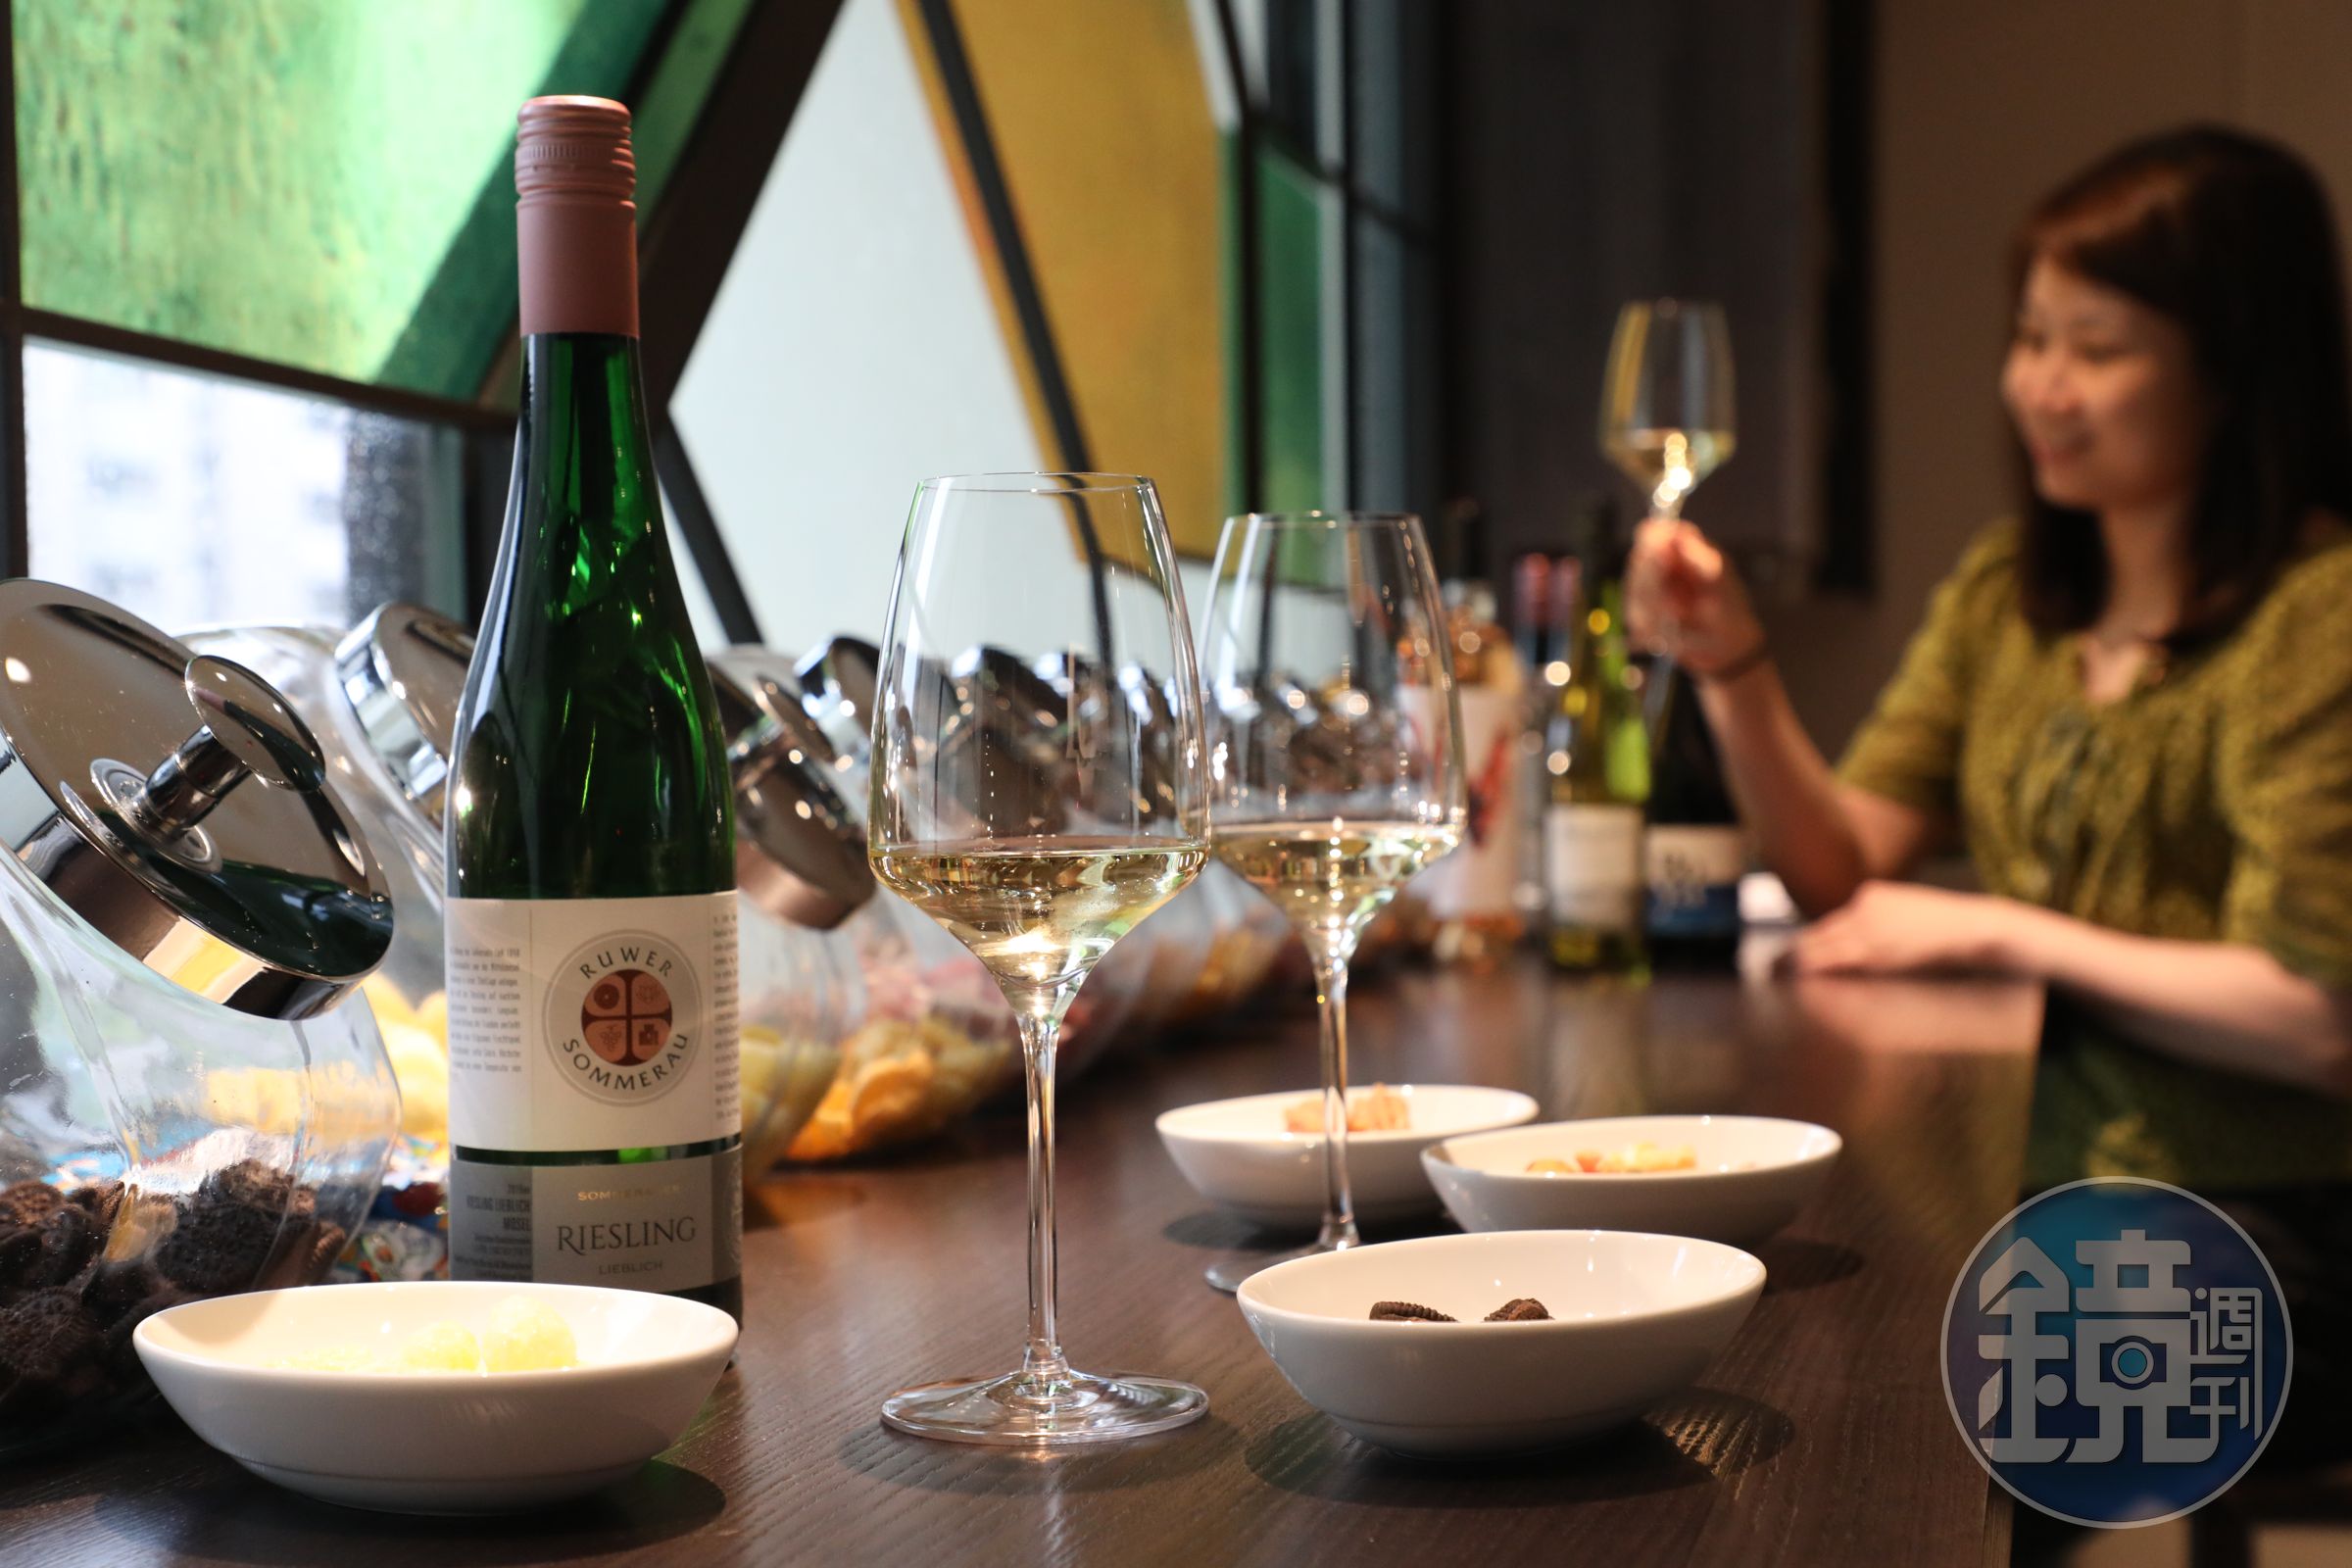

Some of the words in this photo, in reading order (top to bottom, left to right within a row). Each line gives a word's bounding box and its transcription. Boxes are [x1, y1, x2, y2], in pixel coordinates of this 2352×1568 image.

[579, 947, 672, 979] RUWER
[563, 1033, 689, 1091] SOMMERAU
[556, 1215, 696, 1256] RIESLING
[598, 1259, 663, 1276] LIEBLICH
